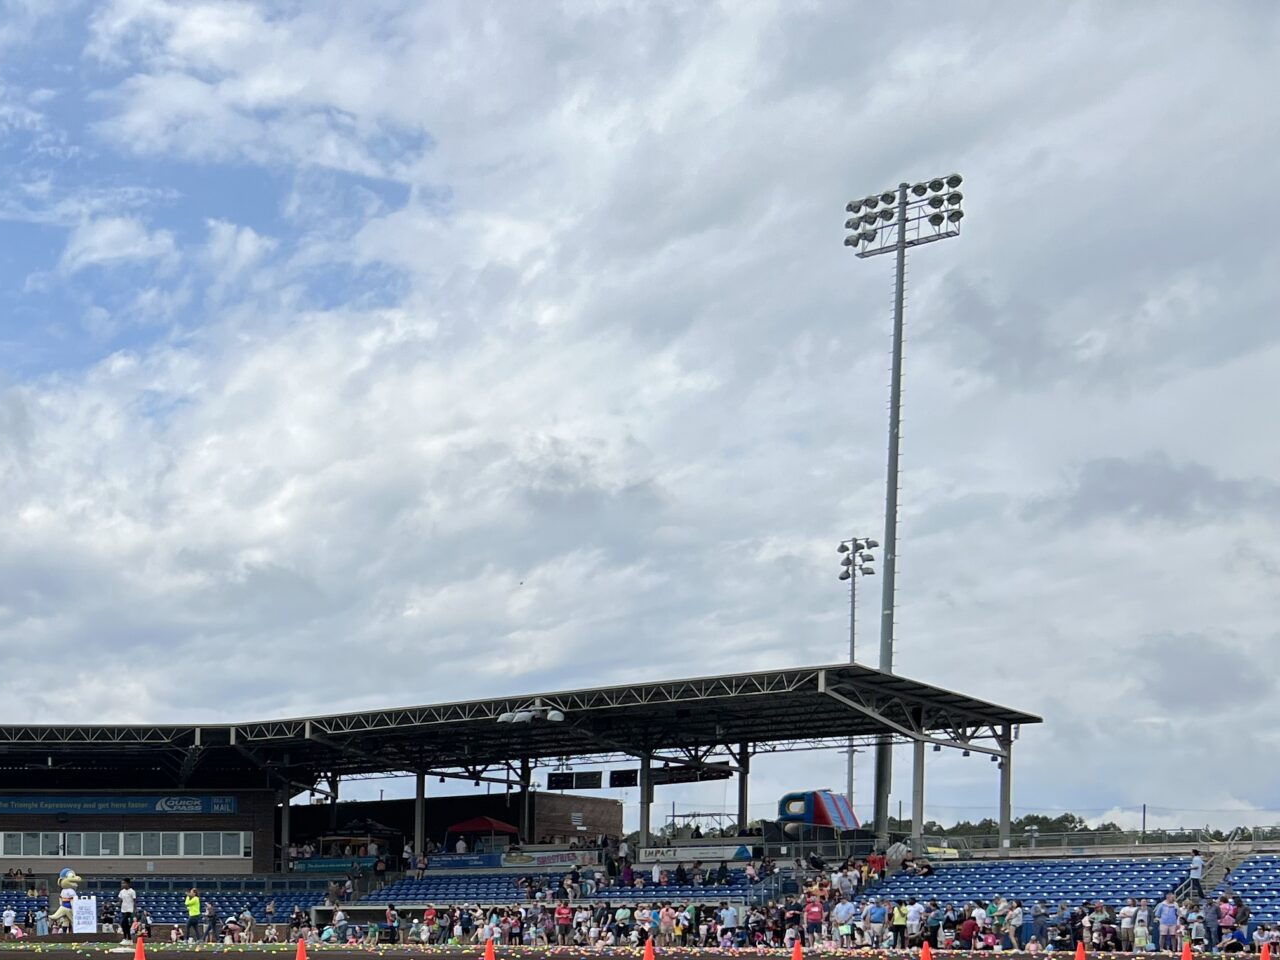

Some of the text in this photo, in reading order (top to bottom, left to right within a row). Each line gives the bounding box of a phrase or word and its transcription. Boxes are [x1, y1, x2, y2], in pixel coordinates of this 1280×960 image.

[10, 801, 38, 809] Triangle
[214, 804, 231, 812] MAIL
[644, 849, 677, 858] IMPACT
